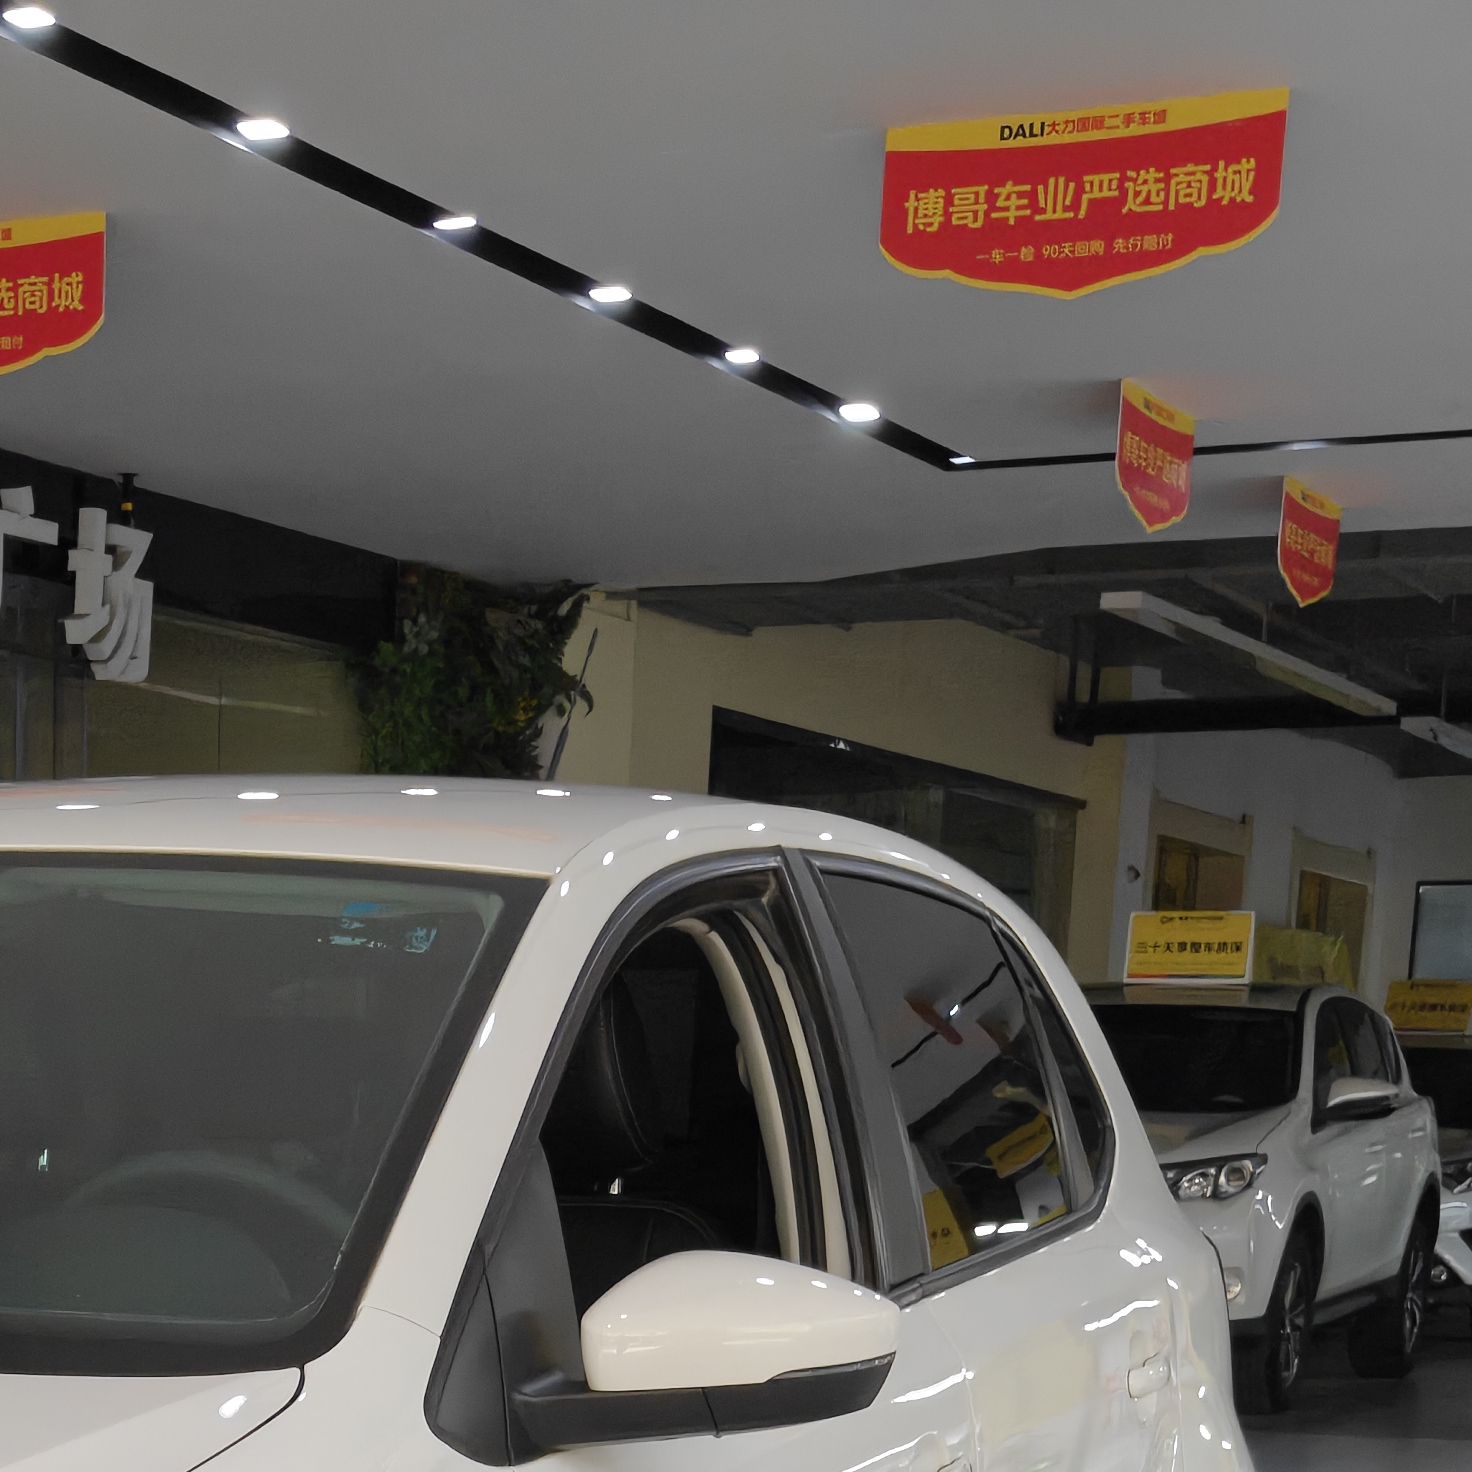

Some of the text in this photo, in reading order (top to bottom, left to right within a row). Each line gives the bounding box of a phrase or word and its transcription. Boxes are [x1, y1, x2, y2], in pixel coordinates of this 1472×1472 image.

[904, 157, 1256, 234] 博哥车业严选商城
